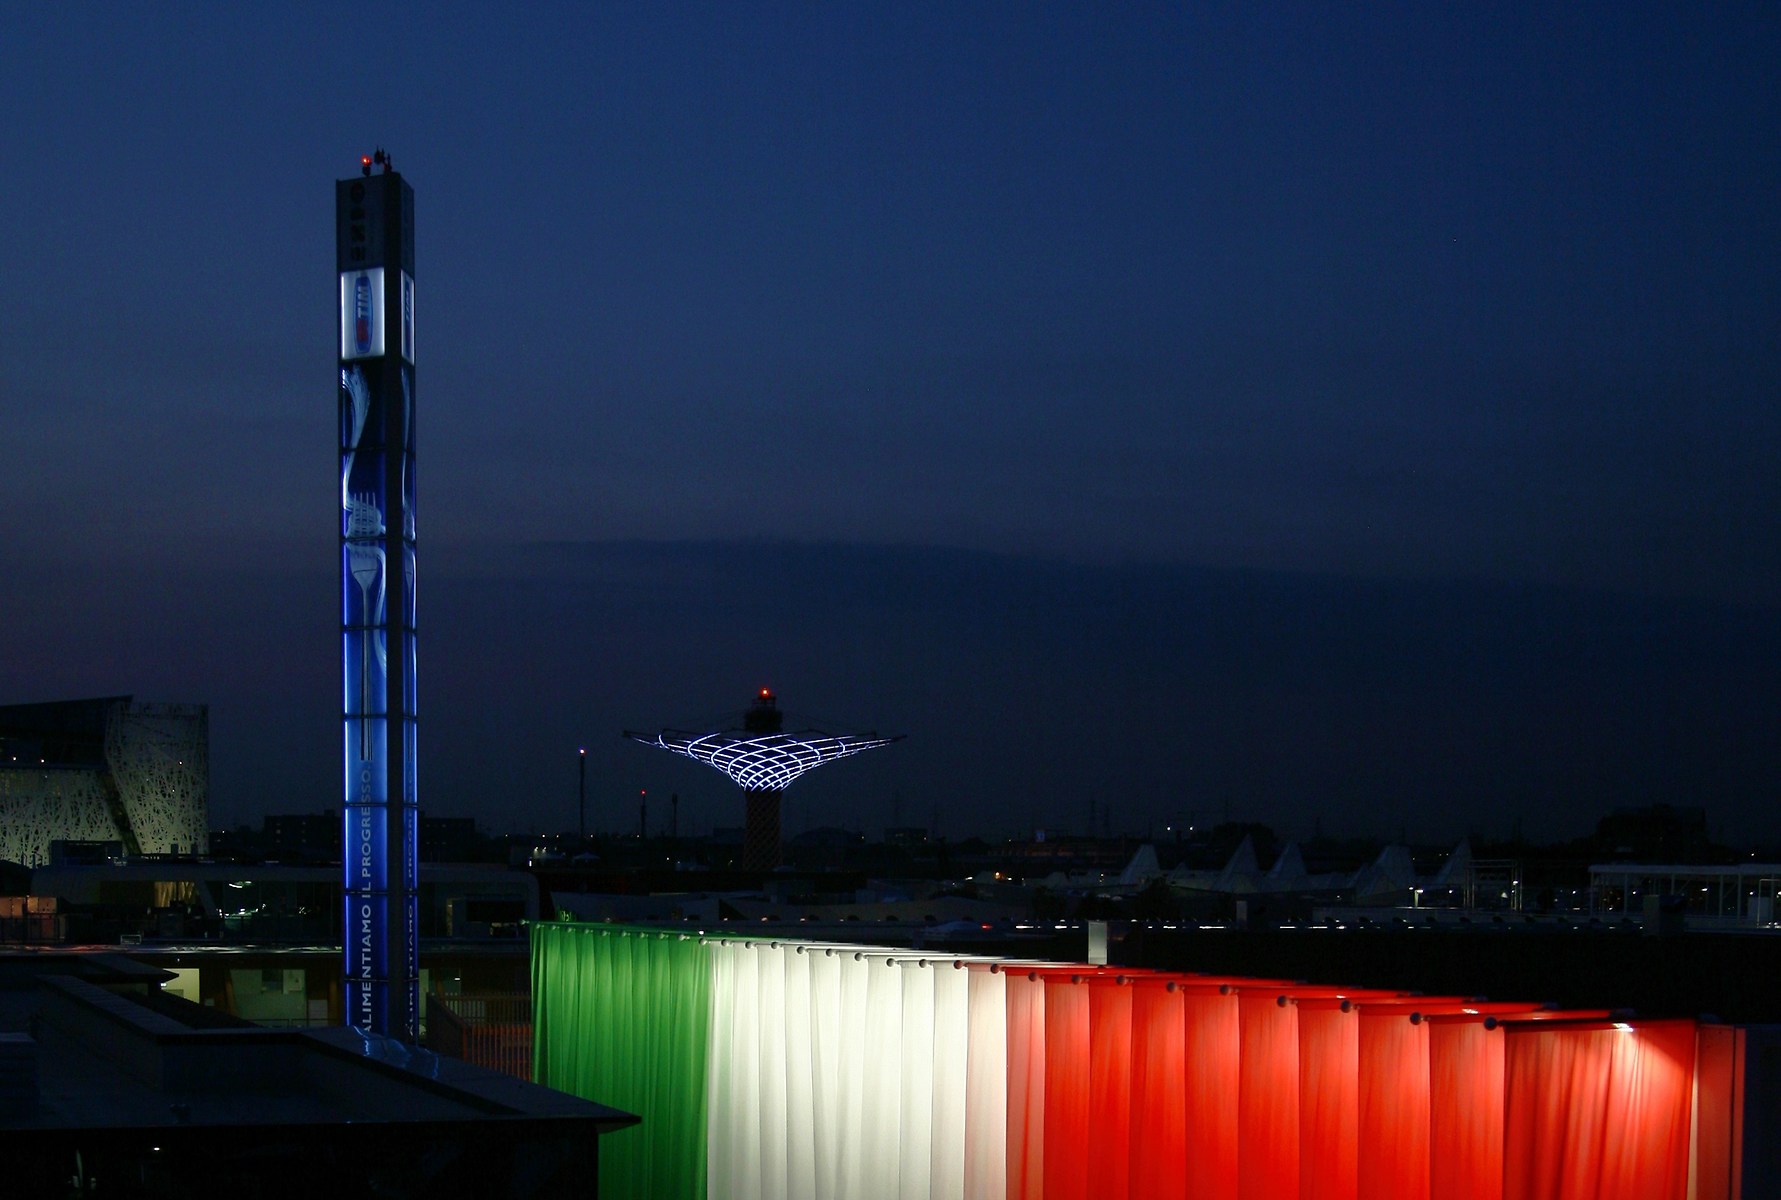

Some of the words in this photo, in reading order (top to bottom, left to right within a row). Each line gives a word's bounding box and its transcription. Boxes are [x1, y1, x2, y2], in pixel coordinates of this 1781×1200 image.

[357, 286, 368, 319] TIM
[361, 882, 372, 899] IL
[361, 904, 372, 1032] ALIMENTIAMO
